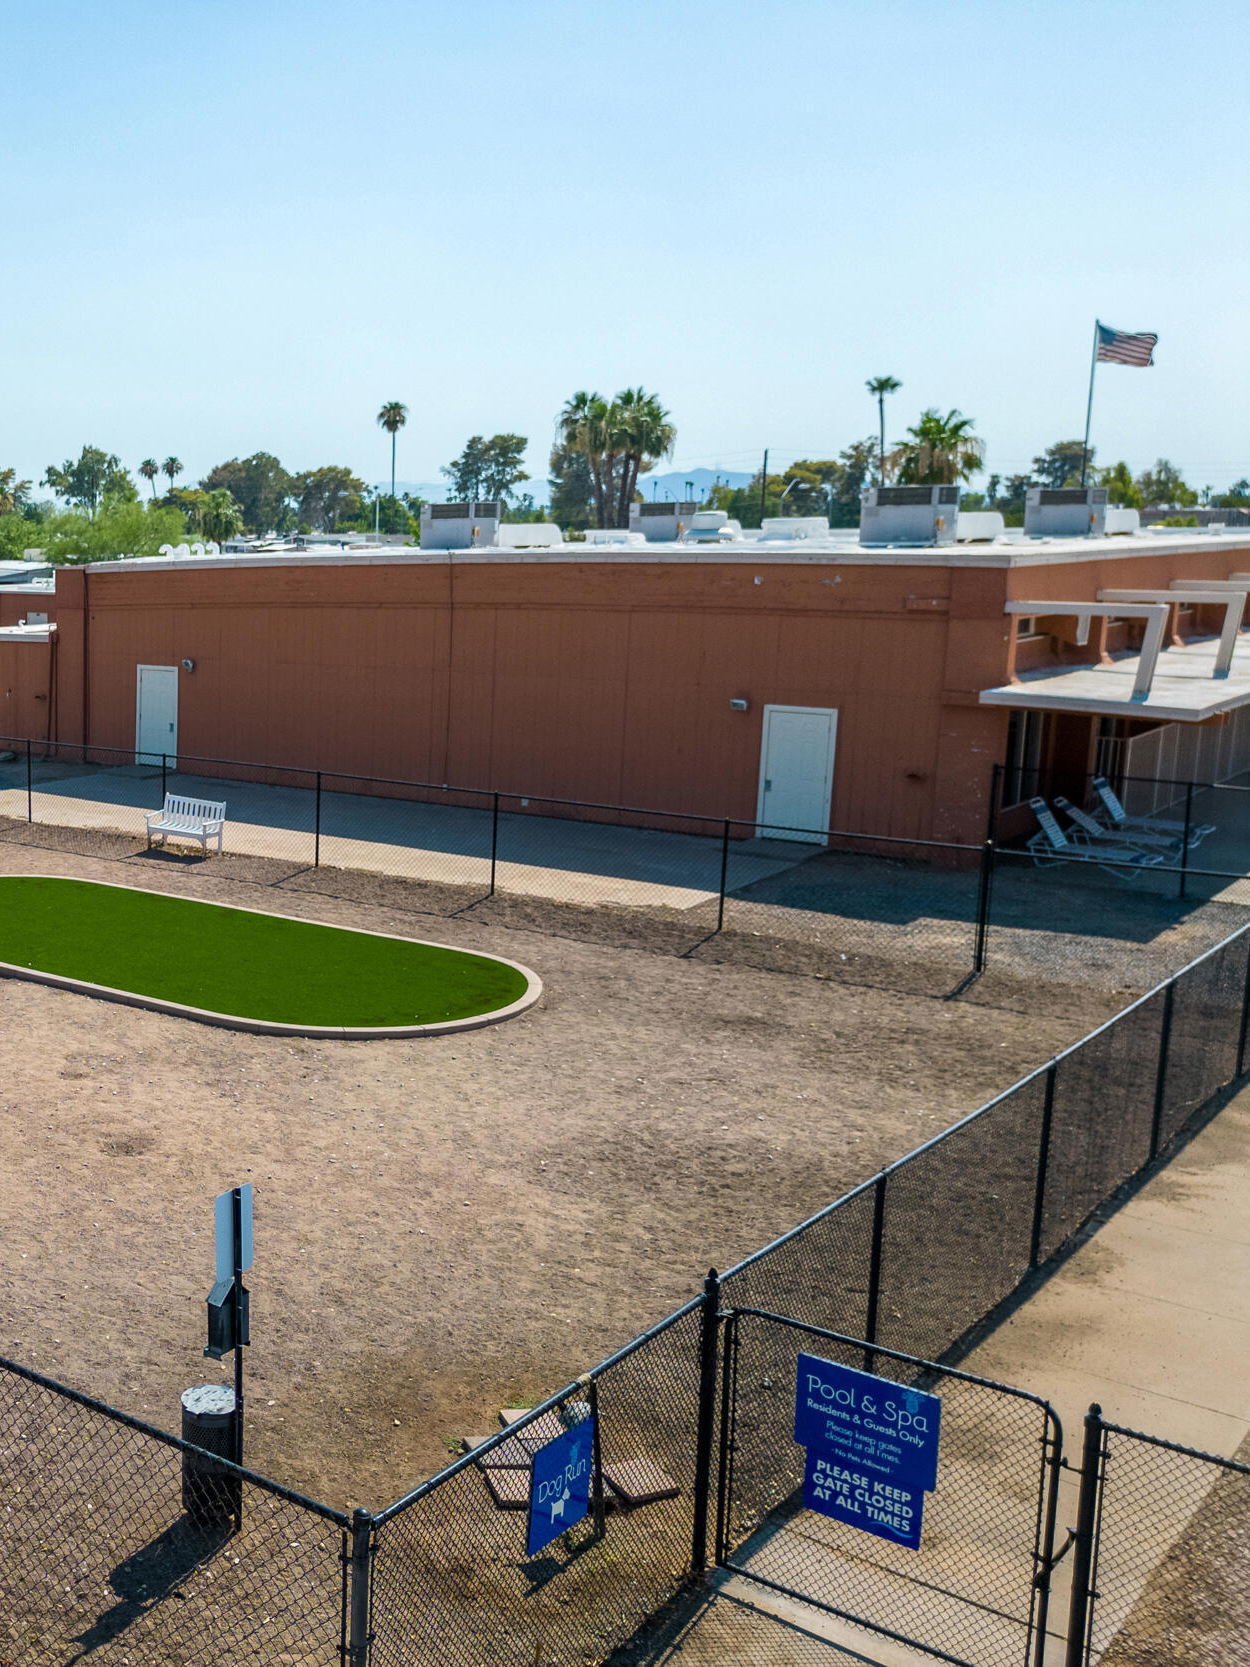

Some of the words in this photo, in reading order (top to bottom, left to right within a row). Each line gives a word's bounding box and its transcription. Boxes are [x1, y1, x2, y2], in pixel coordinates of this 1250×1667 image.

[806, 1374, 856, 1408] Pool
[861, 1395, 877, 1415] &
[883, 1401, 929, 1433] Spa
[807, 1398, 850, 1421] Residents
[852, 1414, 861, 1425] &
[863, 1418, 897, 1437] Guests
[899, 1430, 925, 1448] Only
[824, 1431, 852, 1447] closed
[854, 1442, 862, 1450] at
[864, 1445, 875, 1456] all
[826, 1420, 853, 1437] Please
[855, 1429, 876, 1446] keep
[878, 1440, 902, 1454] gates
[538, 1474, 562, 1504] Dog
[564, 1458, 588, 1484] Run
[812, 1472, 850, 1495] GATE
[854, 1488, 914, 1519] CLOSED
[816, 1459, 869, 1489] PLEASE
[873, 1481, 912, 1503] KEEP
[813, 1486, 832, 1501] AT
[835, 1495, 861, 1514] ALL
[865, 1505, 911, 1532] TIMES
